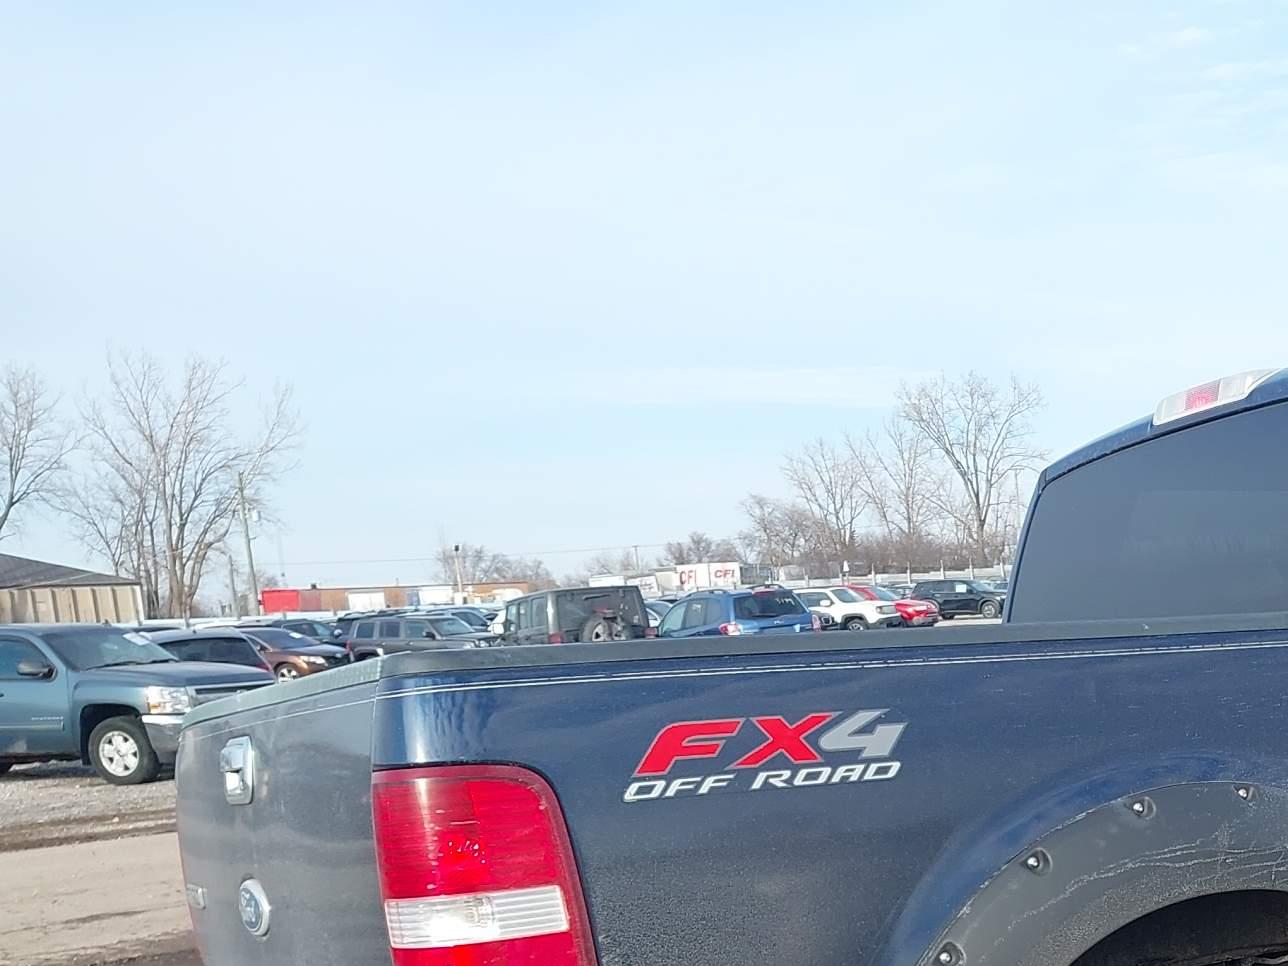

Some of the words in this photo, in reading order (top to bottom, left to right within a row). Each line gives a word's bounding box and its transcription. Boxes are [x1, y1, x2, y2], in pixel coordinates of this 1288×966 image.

[632, 708, 908, 777] FX4
[622, 773, 737, 801] OFF
[751, 761, 901, 790] ROAD
